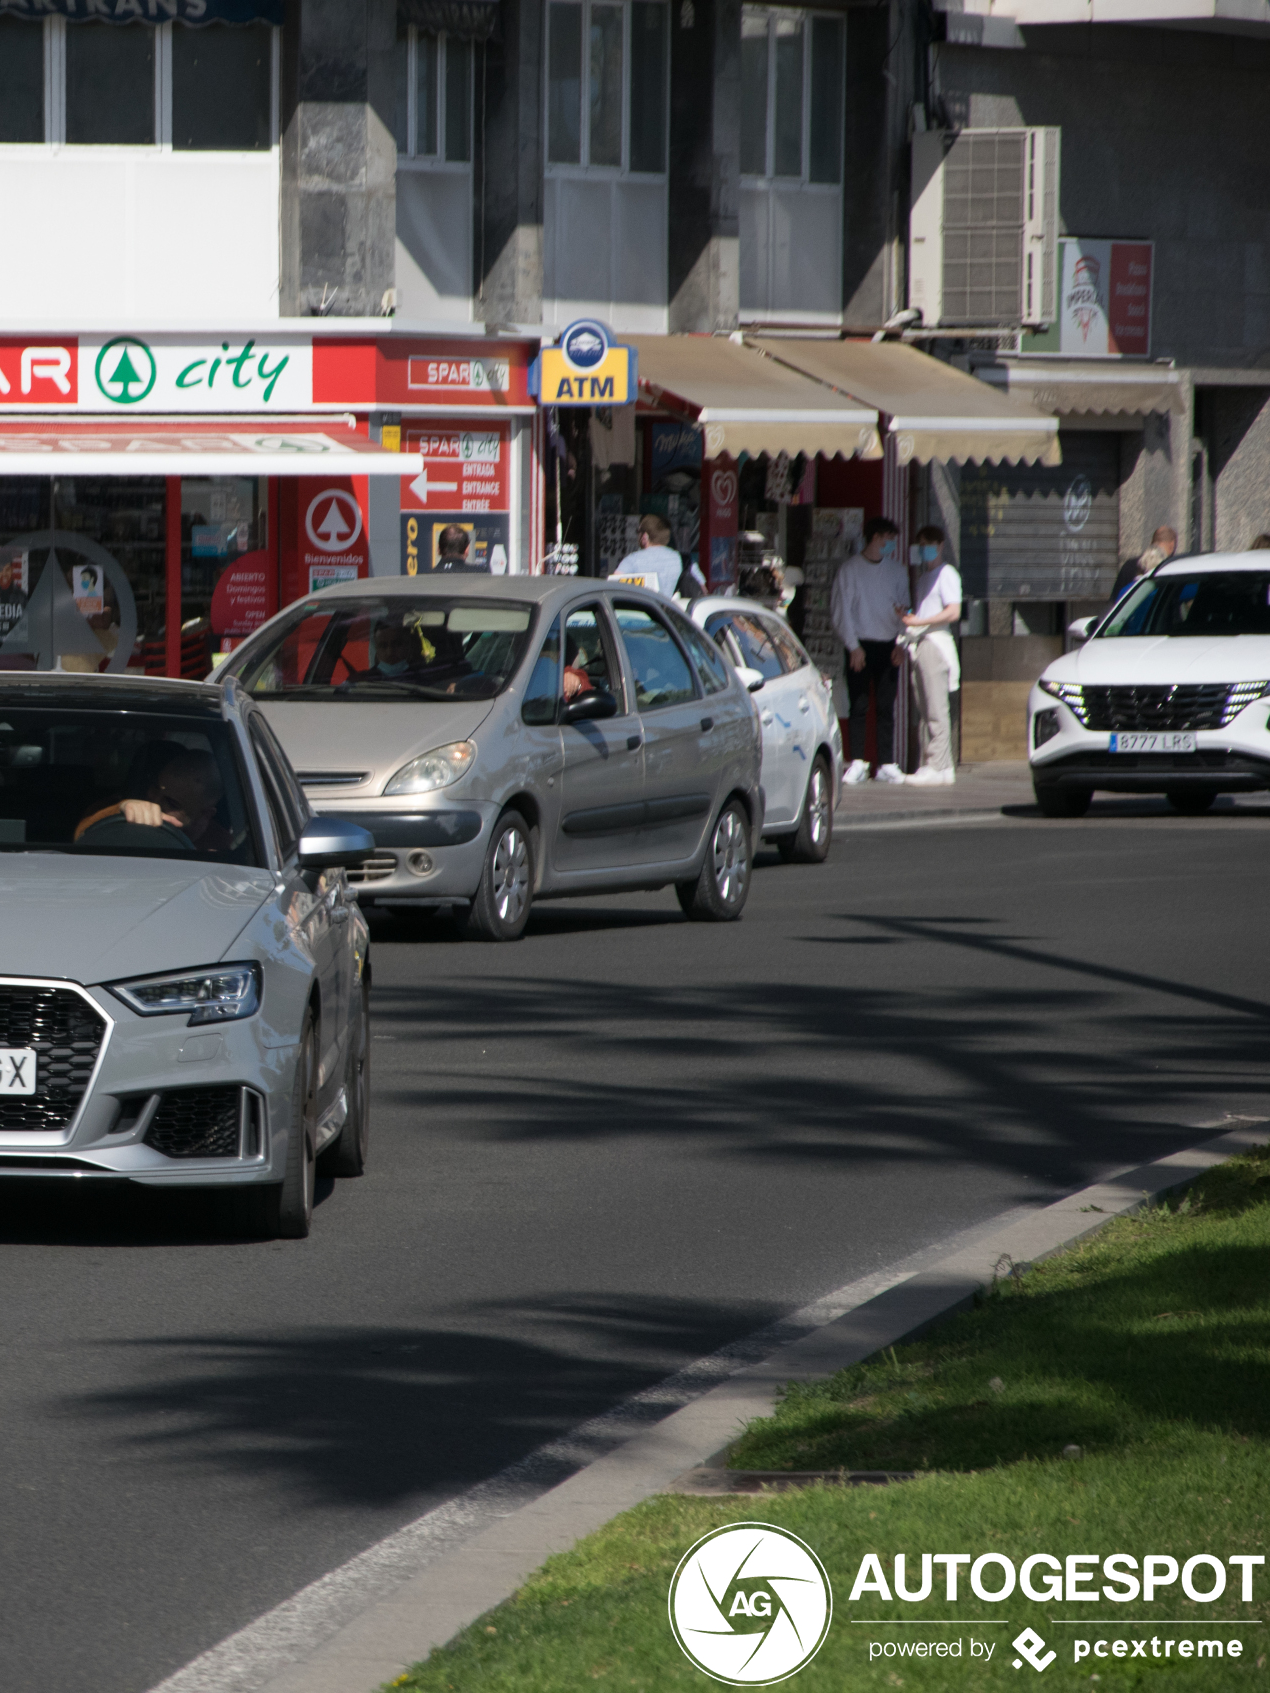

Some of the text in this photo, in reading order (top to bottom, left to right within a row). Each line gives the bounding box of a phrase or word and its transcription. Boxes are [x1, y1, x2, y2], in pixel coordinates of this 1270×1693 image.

[175, 339, 290, 403] city
[427, 362, 506, 385] SPAR city
[556, 377, 614, 398] ATM
[420, 432, 500, 458] SPAR city
[462, 463, 495, 477] ENTRADA
[462, 481, 500, 496] ENTRANCE
[462, 499, 490, 512] ENTRÉE
[305, 553, 363, 565] Bienvenidos
[230, 572, 265, 582] ABIERTO
[226, 584, 265, 594] Domingos
[230, 595, 265, 606] y festivos
[245, 610, 266, 619] OPEN
[1120, 734, 1193, 750] 8777 LRS
